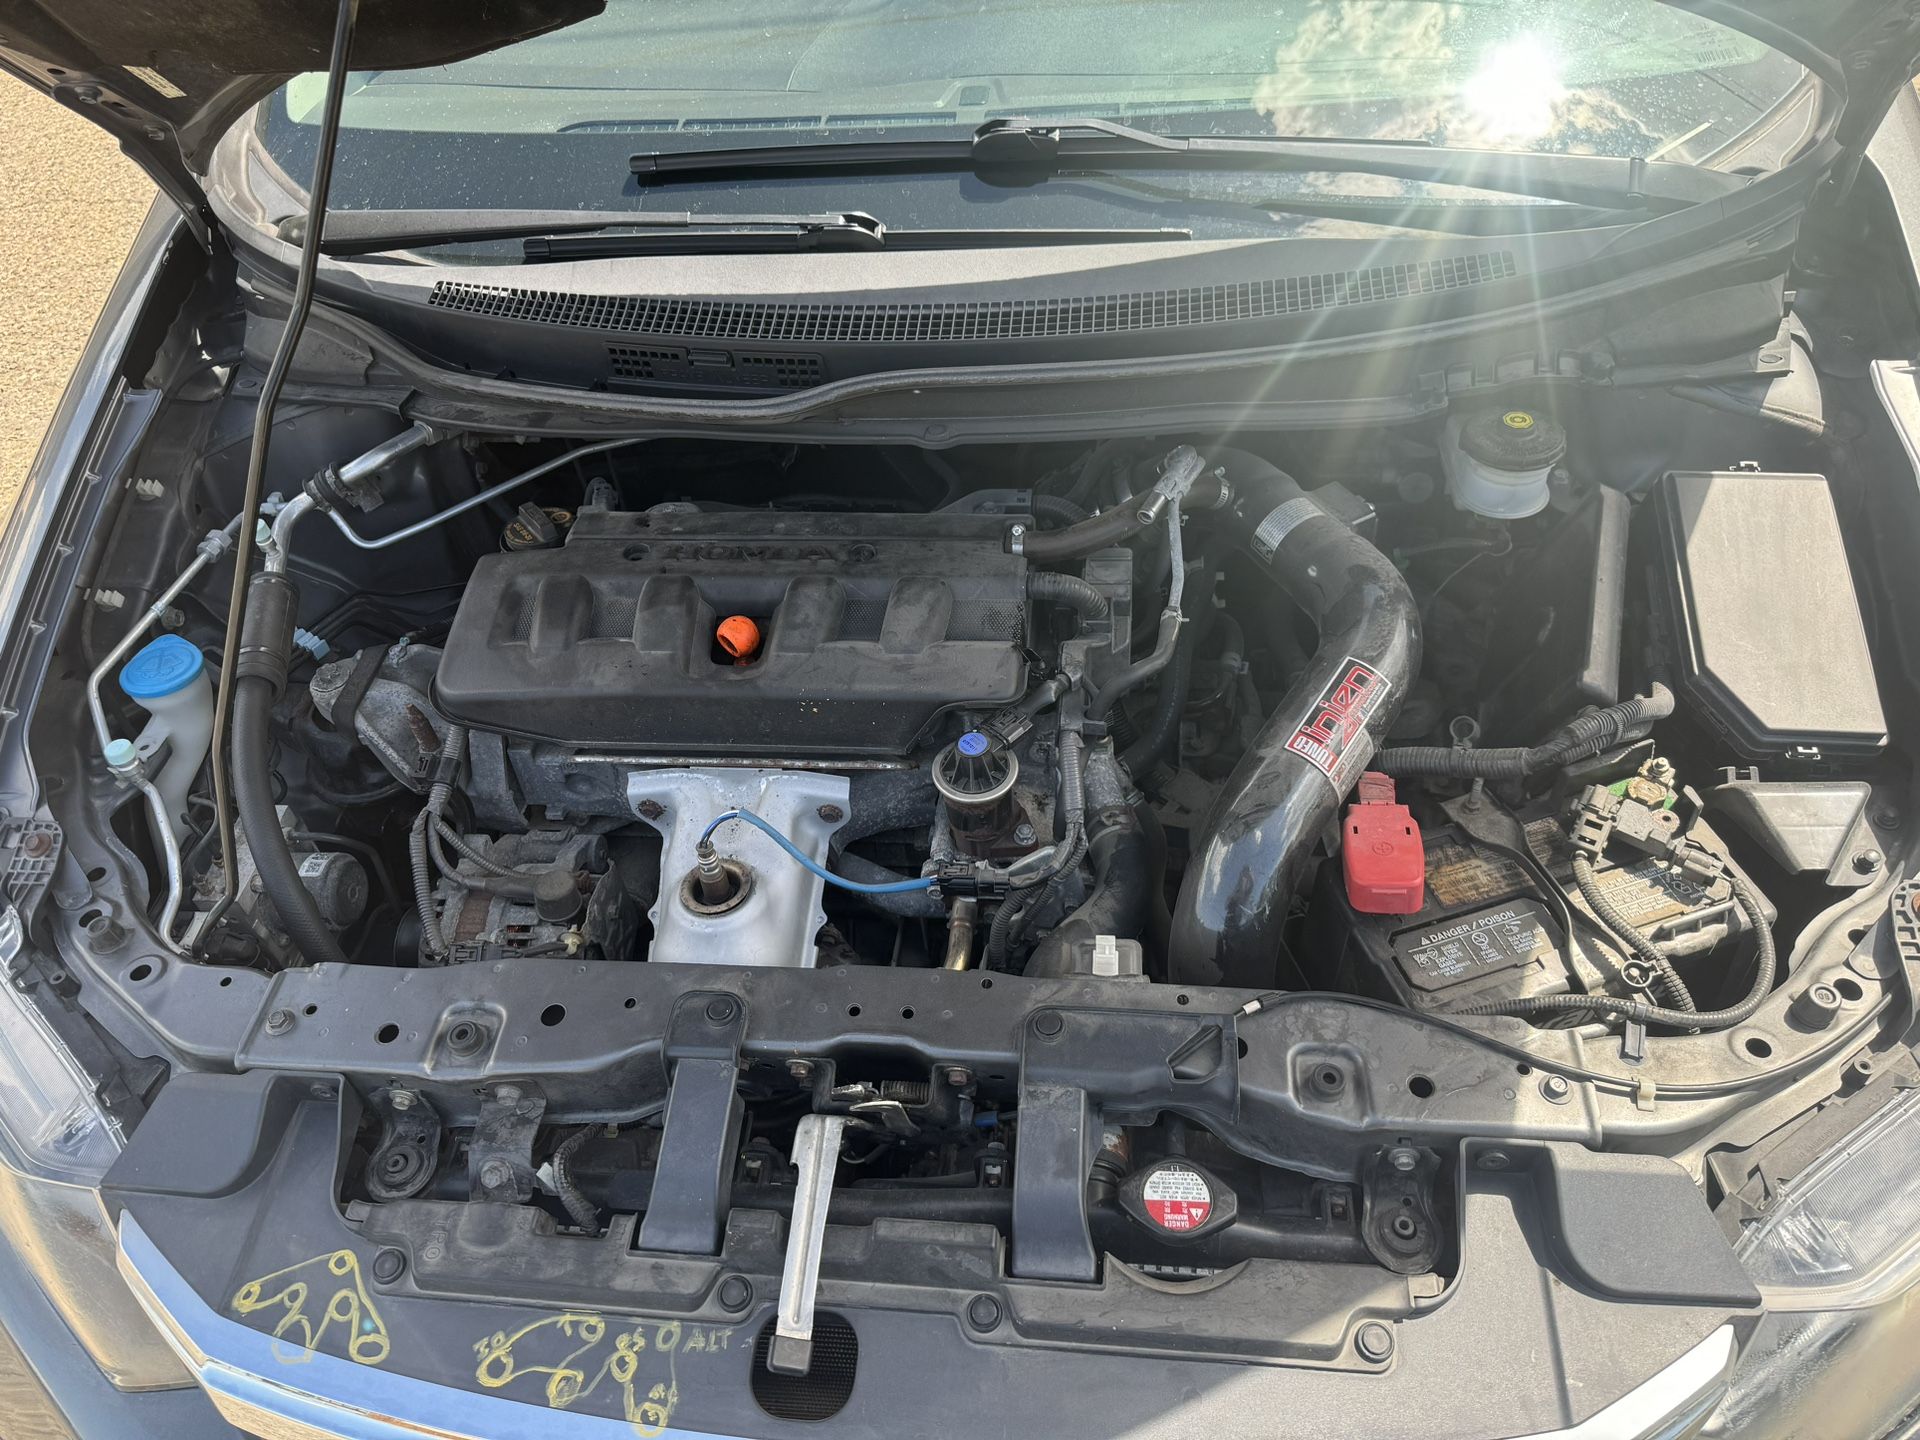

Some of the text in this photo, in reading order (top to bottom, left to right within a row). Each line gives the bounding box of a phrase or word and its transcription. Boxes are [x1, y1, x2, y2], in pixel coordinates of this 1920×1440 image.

[1301, 665, 1377, 750] injen
[1293, 734, 1335, 772] TUNED
[1429, 924, 1471, 943] DANGER
[1478, 910, 1516, 928] POISON
[1164, 1220, 1189, 1228] DANGER
[682, 1327, 733, 1353] ALT
